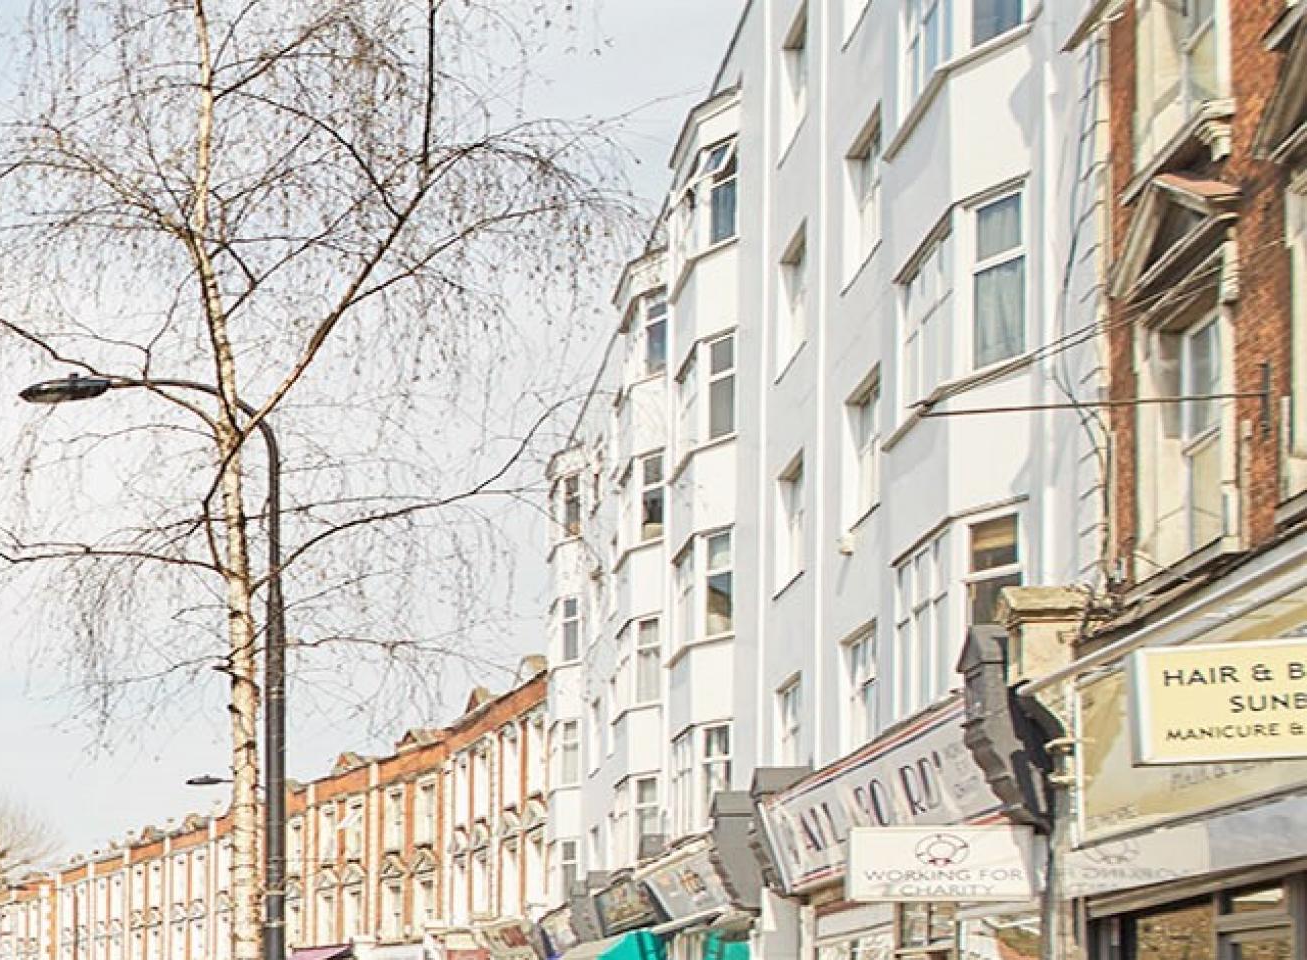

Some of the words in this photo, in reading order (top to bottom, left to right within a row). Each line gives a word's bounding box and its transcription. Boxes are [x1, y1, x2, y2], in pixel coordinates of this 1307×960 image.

[1163, 666, 1240, 687] HAIR
[1252, 663, 1274, 682] &
[1166, 722, 1280, 742] MANICURE
[1290, 722, 1305, 736] &
[865, 868, 971, 881] WORKING
[980, 868, 1024, 881] FOR
[899, 884, 995, 897] CHARITY
